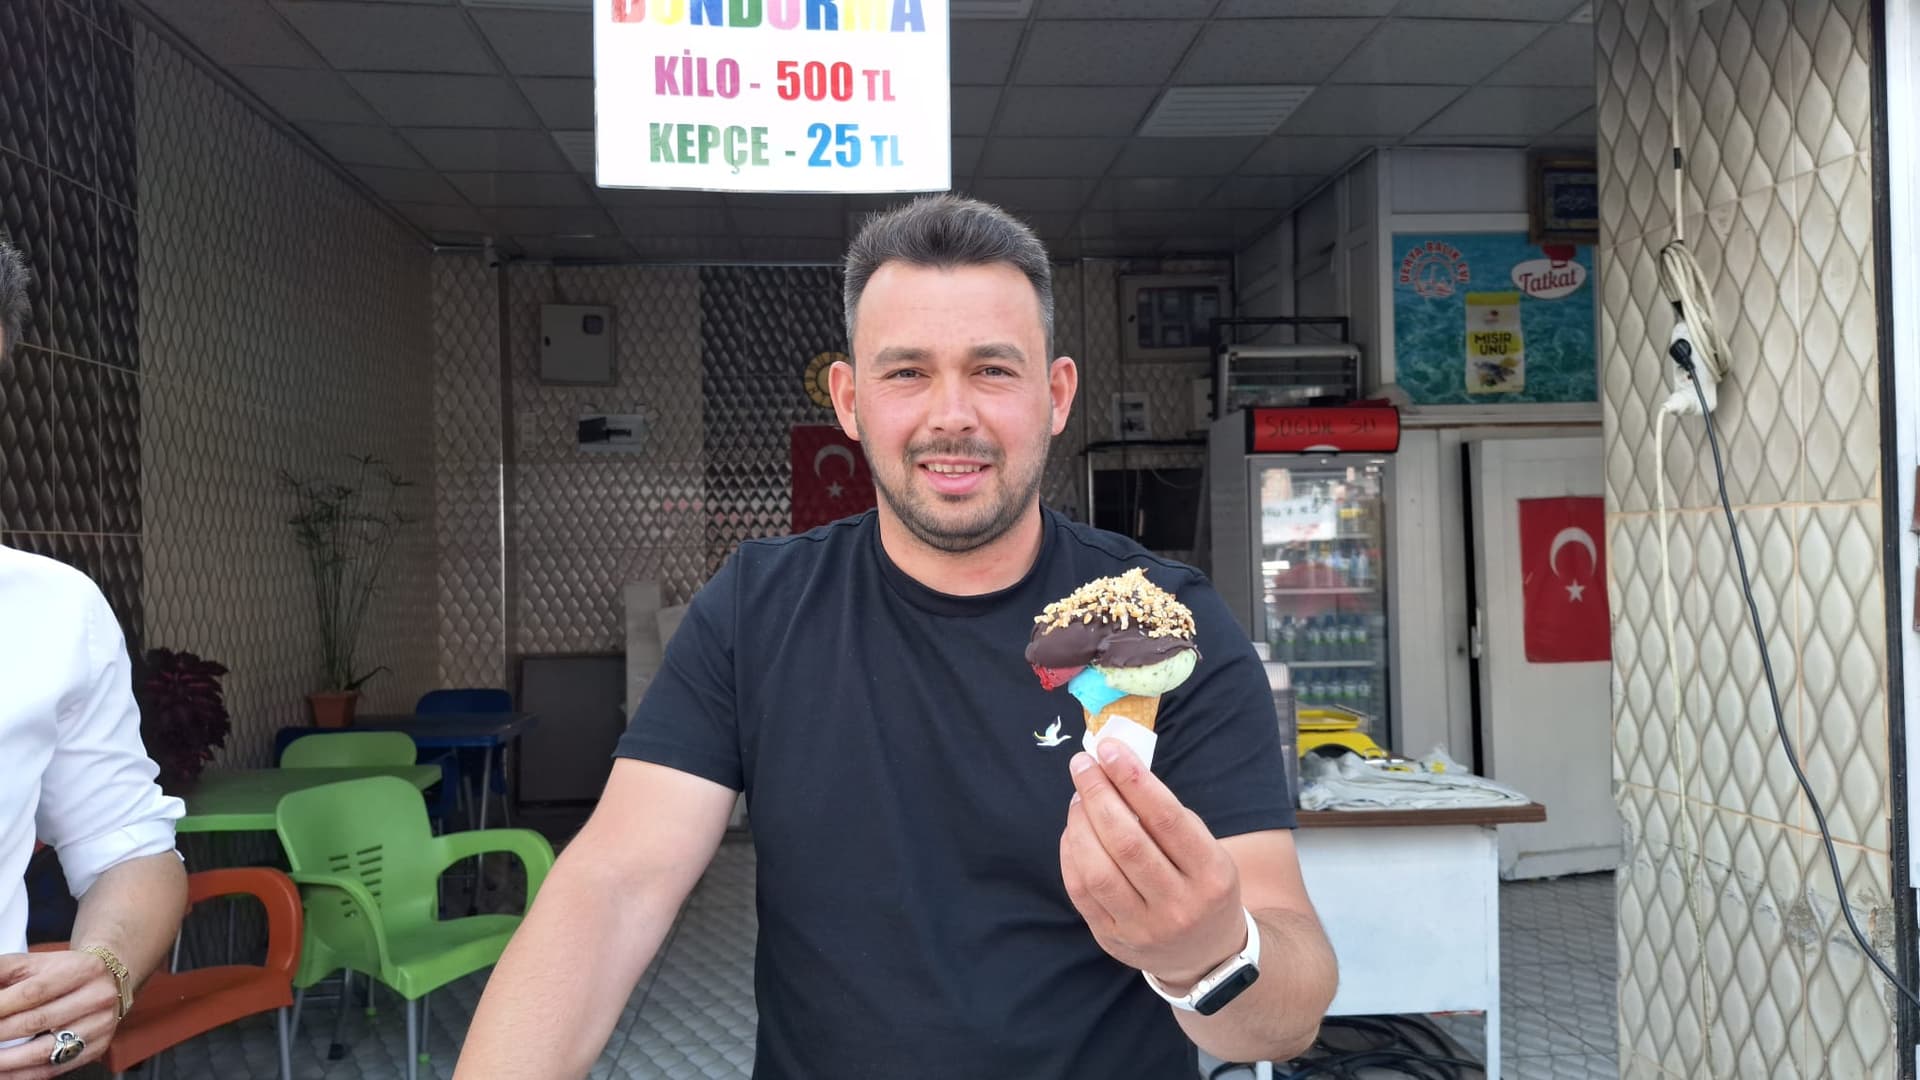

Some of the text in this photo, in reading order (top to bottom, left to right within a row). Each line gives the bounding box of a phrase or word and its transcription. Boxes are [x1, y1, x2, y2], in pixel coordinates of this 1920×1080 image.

[655, 48, 740, 99] KİLO
[777, 60, 854, 102] 500
[862, 69, 896, 101] TL
[649, 122, 770, 174] KEPÇE
[807, 122, 862, 168] 25
[870, 134, 904, 166] TL
[1480, 344, 1508, 356] UNU
